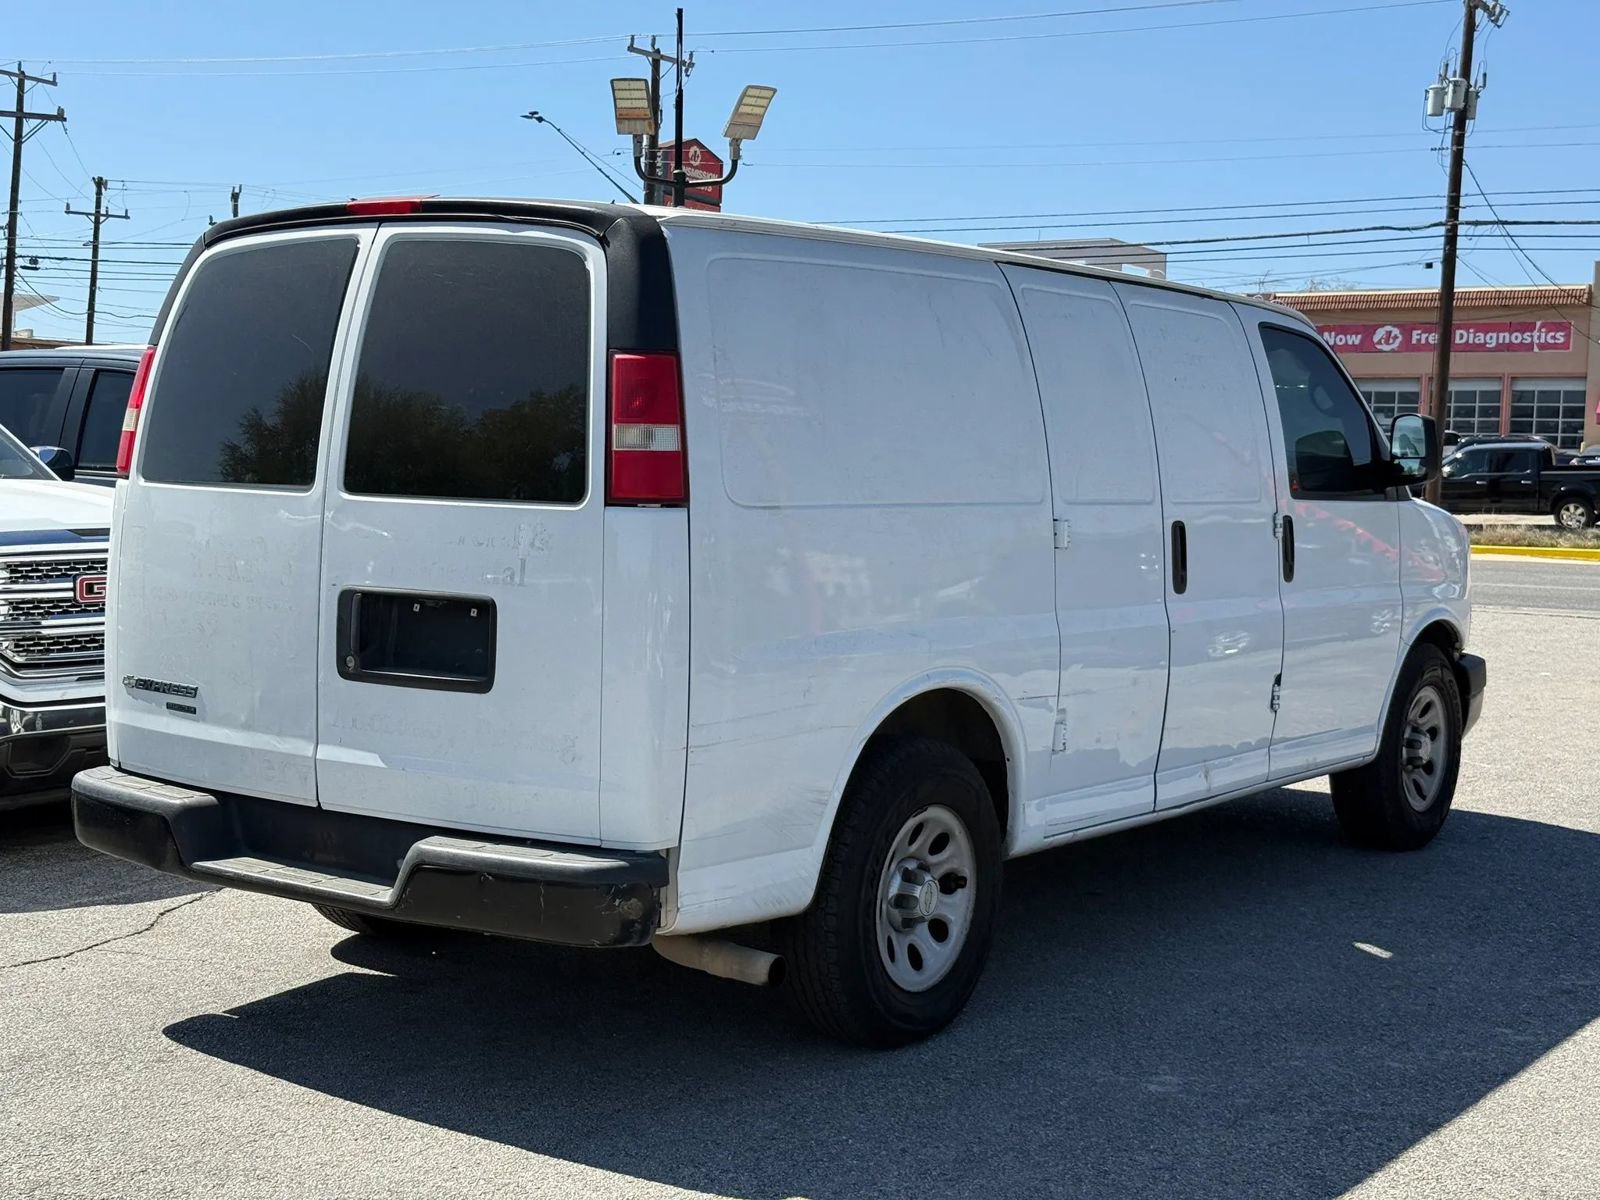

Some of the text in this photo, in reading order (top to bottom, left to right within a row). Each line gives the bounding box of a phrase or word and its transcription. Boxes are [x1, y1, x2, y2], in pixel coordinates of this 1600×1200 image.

[1323, 331, 1362, 346] Now
[1411, 329, 1438, 345] Fre
[1455, 328, 1566, 348] Diagnostics
[135, 678, 199, 699] EXPRESS
